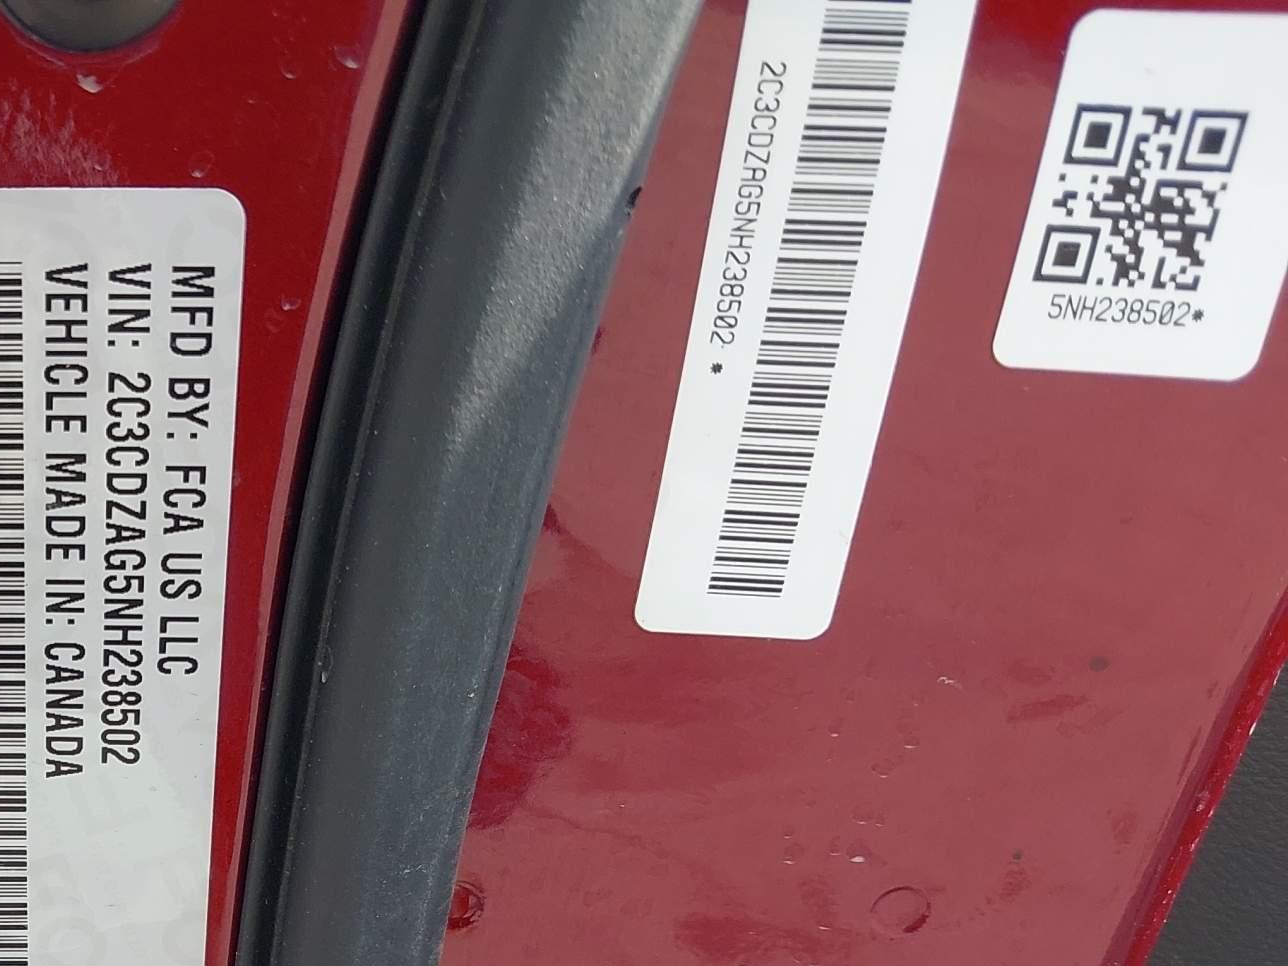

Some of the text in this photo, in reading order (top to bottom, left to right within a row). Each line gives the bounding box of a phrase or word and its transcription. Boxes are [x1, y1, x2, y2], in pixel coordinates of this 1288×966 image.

[710, 60, 788, 346] 2C3CDZAG5NH238502
[44, 263, 88, 778] VEHICLE MADE IN: CANADA
[101, 263, 152, 764] VIN: 2C3CDZAG5NH238502
[157, 266, 215, 674] MFD BY: FCA US LLC
